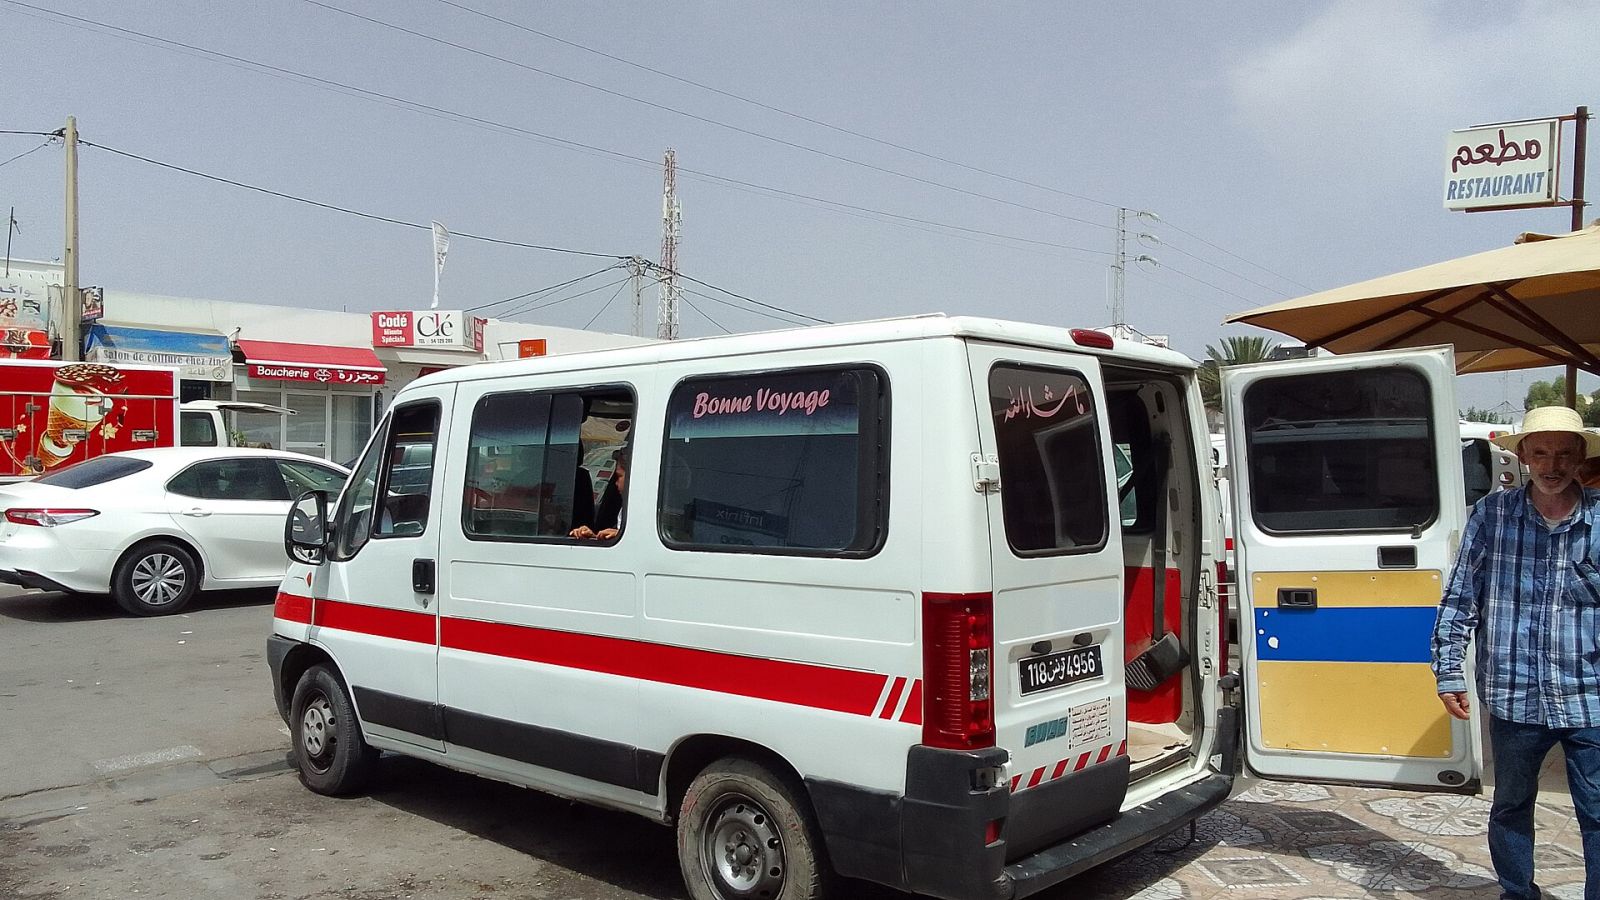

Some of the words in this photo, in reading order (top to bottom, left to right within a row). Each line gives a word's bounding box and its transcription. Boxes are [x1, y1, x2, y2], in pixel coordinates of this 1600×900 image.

[1452, 129, 1541, 173] مطعم
[1446, 171, 1545, 200] RESTAURANT
[378, 313, 407, 328] Codé
[417, 313, 453, 337] Clé
[103, 349, 130, 361] Salon
[133, 351, 144, 362] de
[256, 365, 310, 378] Boucherie
[337, 369, 379, 383] مجزرة
[693, 392, 753, 418] Bonne
[756, 387, 830, 416] Voyage
[1028, 661, 1047, 687] 118
[1067, 651, 1095, 677] 4956
